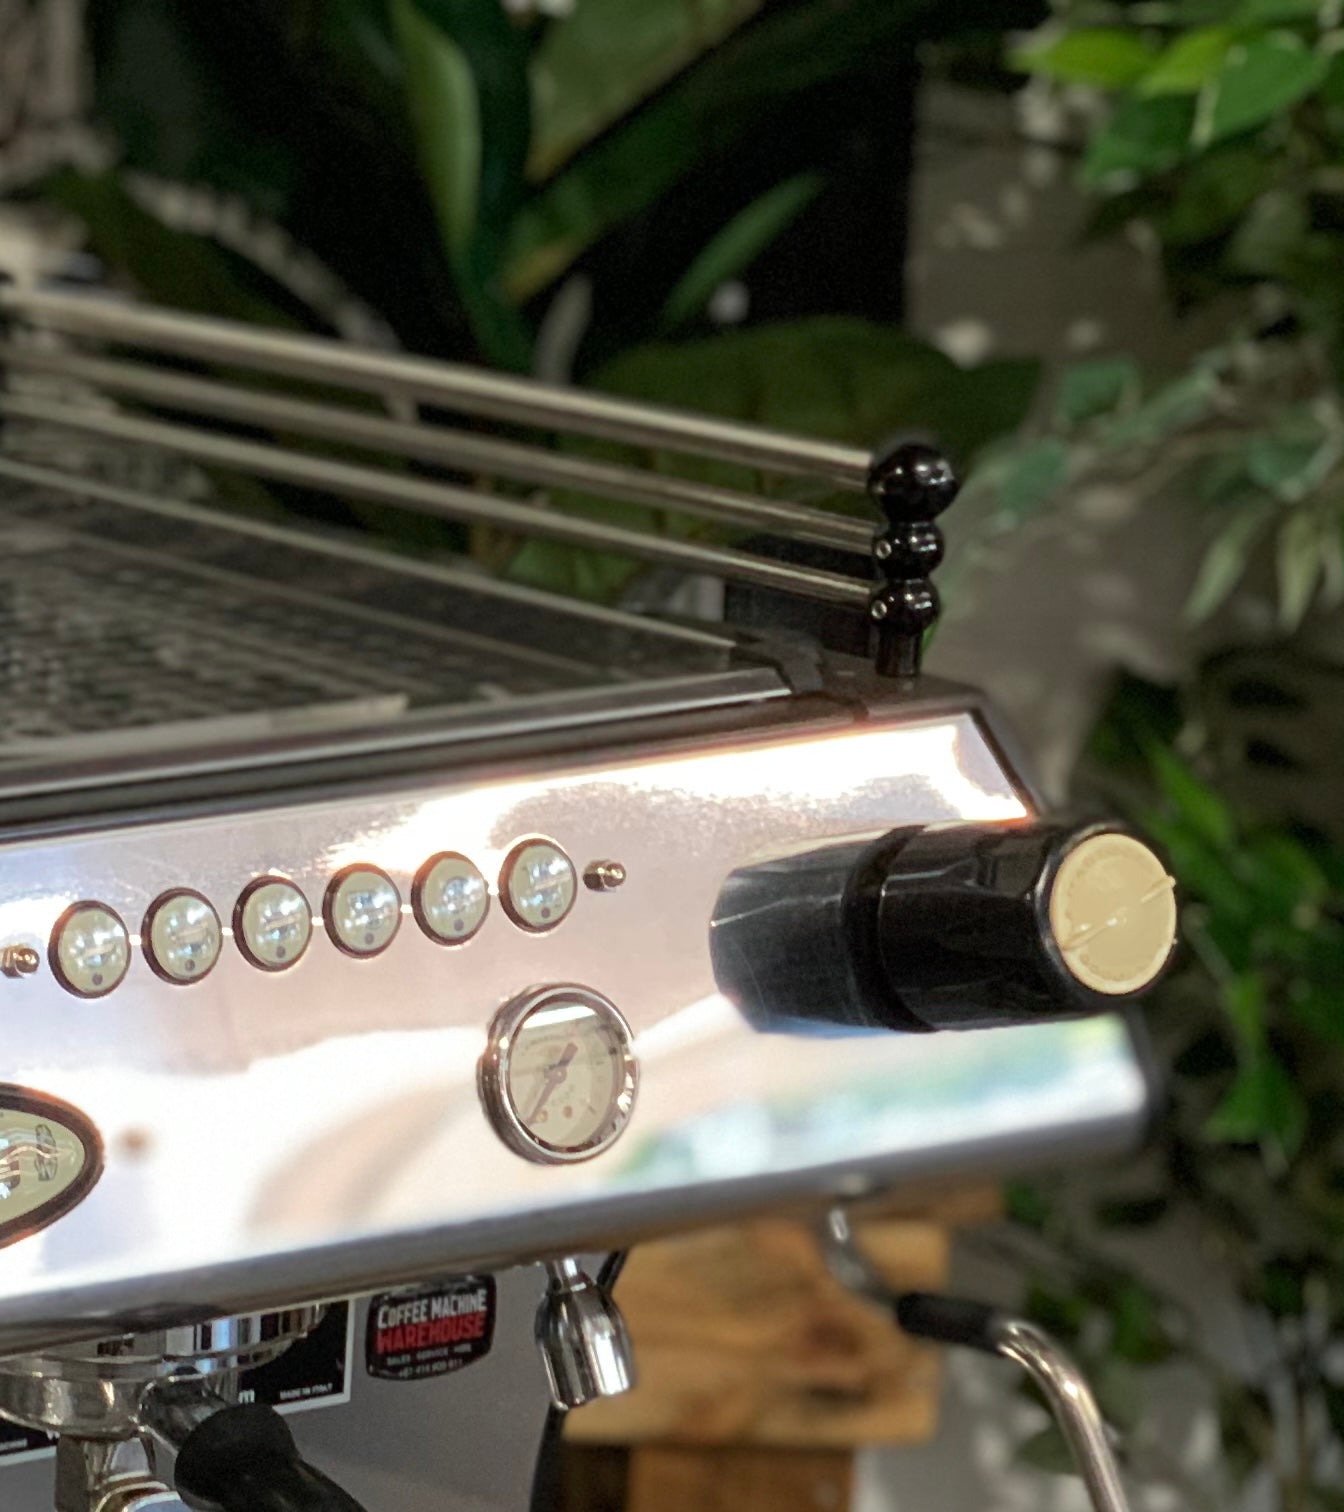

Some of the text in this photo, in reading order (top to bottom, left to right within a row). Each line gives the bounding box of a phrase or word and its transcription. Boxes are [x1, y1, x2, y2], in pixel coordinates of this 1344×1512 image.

[377, 1288, 488, 1330] COFFEE MACHINE
[375, 1311, 485, 1355] WAREHOUSE
